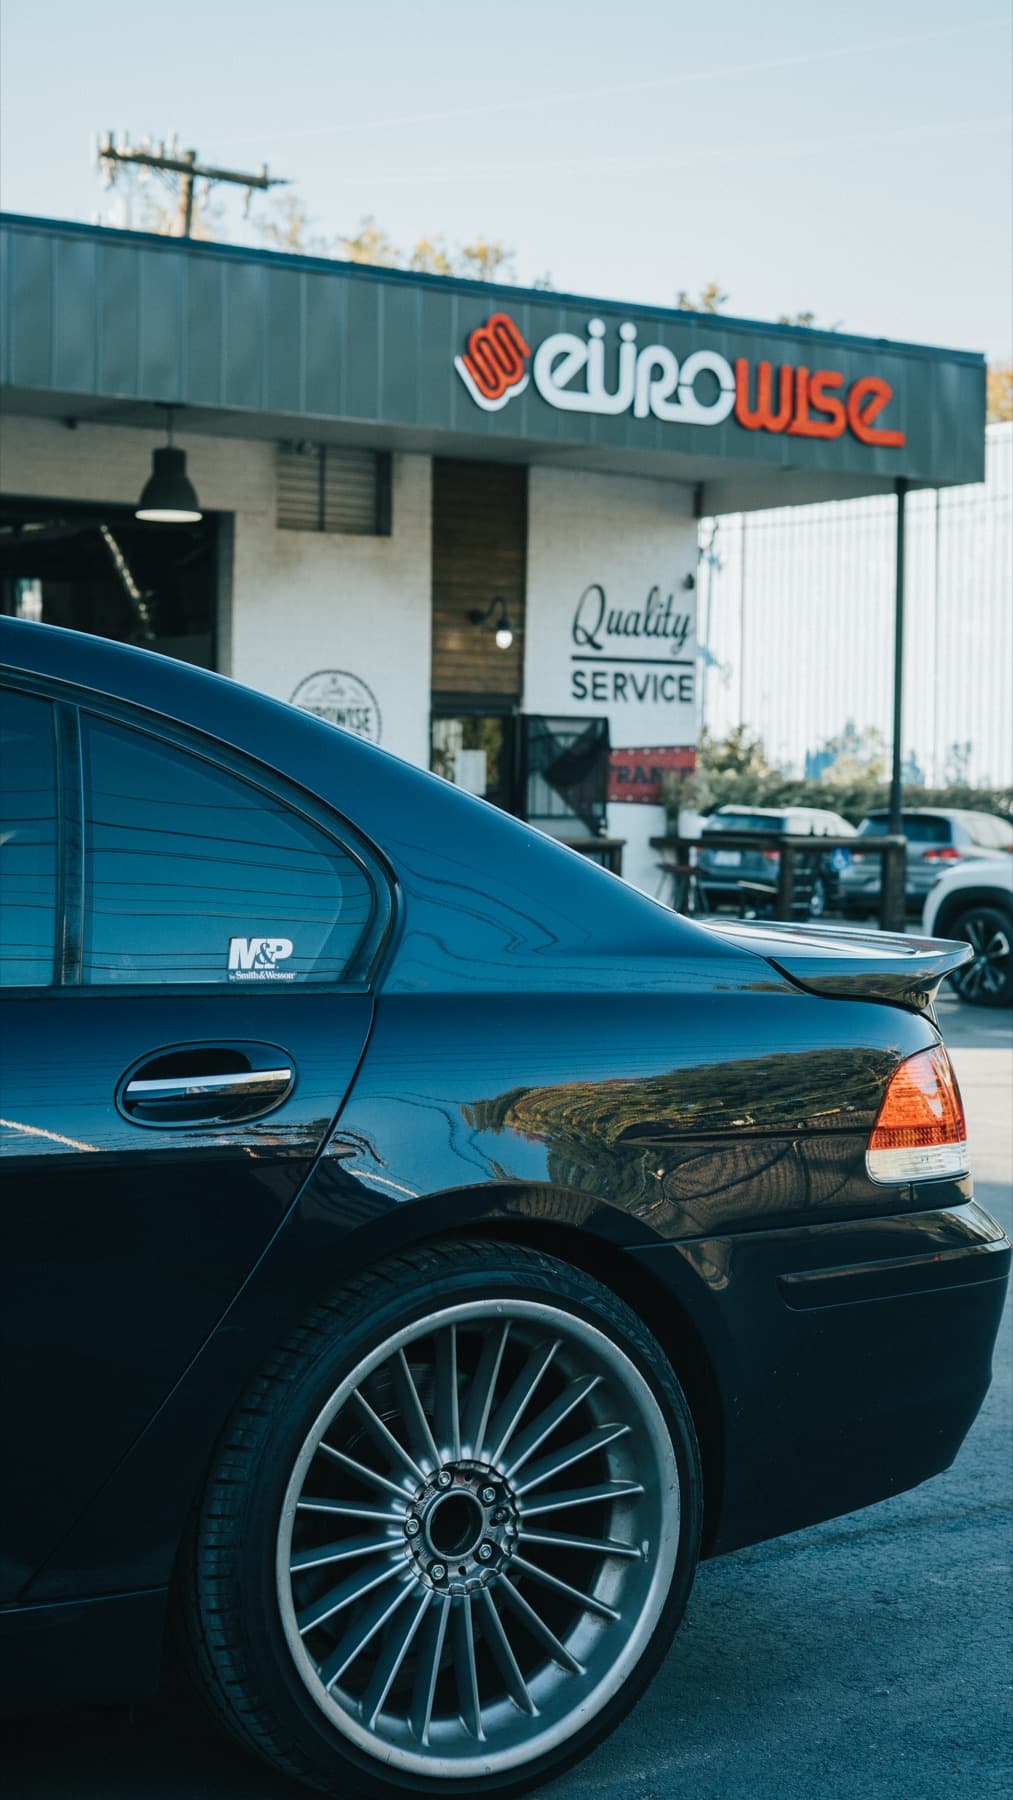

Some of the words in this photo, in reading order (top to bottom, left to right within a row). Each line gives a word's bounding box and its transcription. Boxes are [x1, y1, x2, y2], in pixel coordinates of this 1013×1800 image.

[572, 583, 691, 655] Quality
[571, 671, 693, 703] SERVICE
[228, 938, 293, 969] M&P
